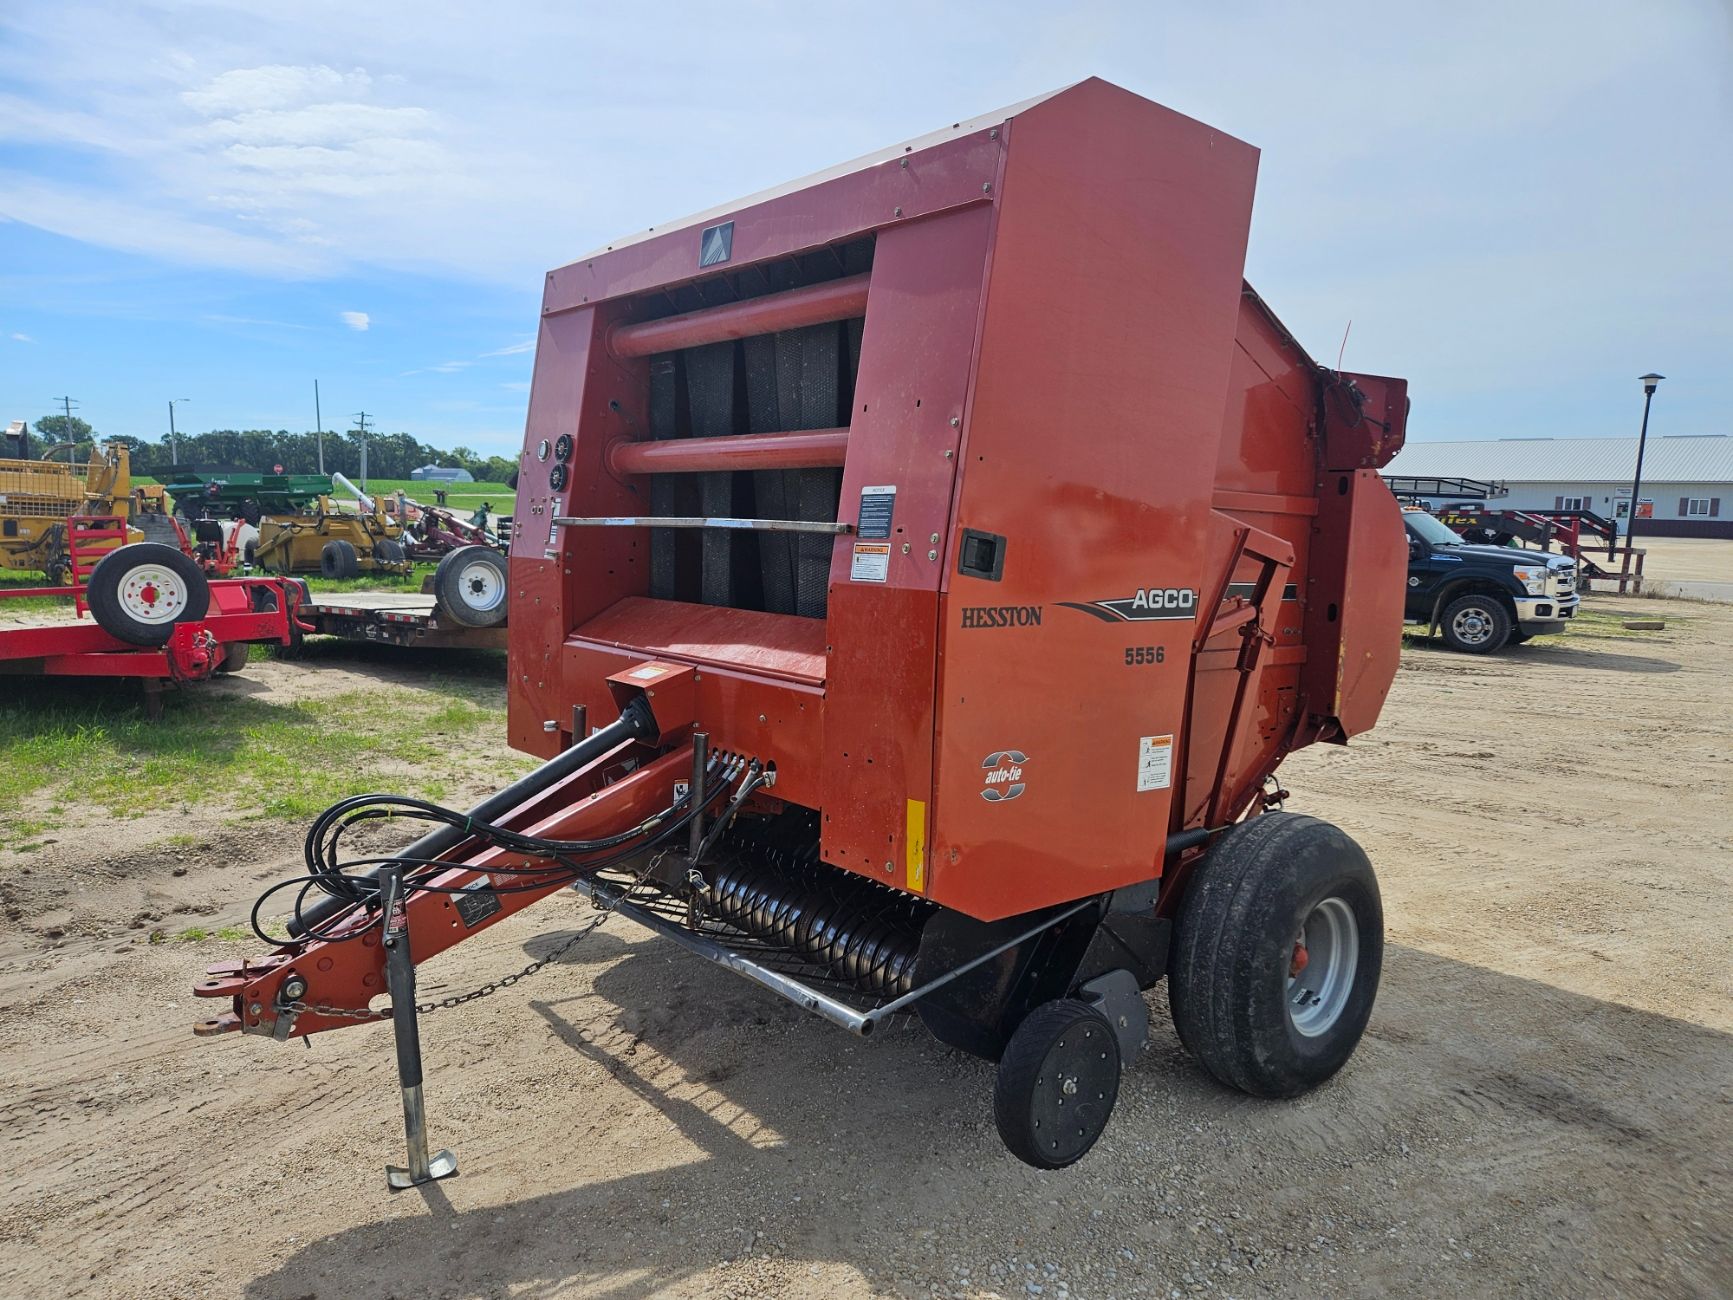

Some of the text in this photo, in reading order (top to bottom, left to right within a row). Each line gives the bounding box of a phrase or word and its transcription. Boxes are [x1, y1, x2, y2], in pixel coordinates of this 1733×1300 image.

[1132, 588, 1194, 609] AGCO
[961, 606, 1043, 628] HESSTON
[1125, 646, 1165, 666] 5556
